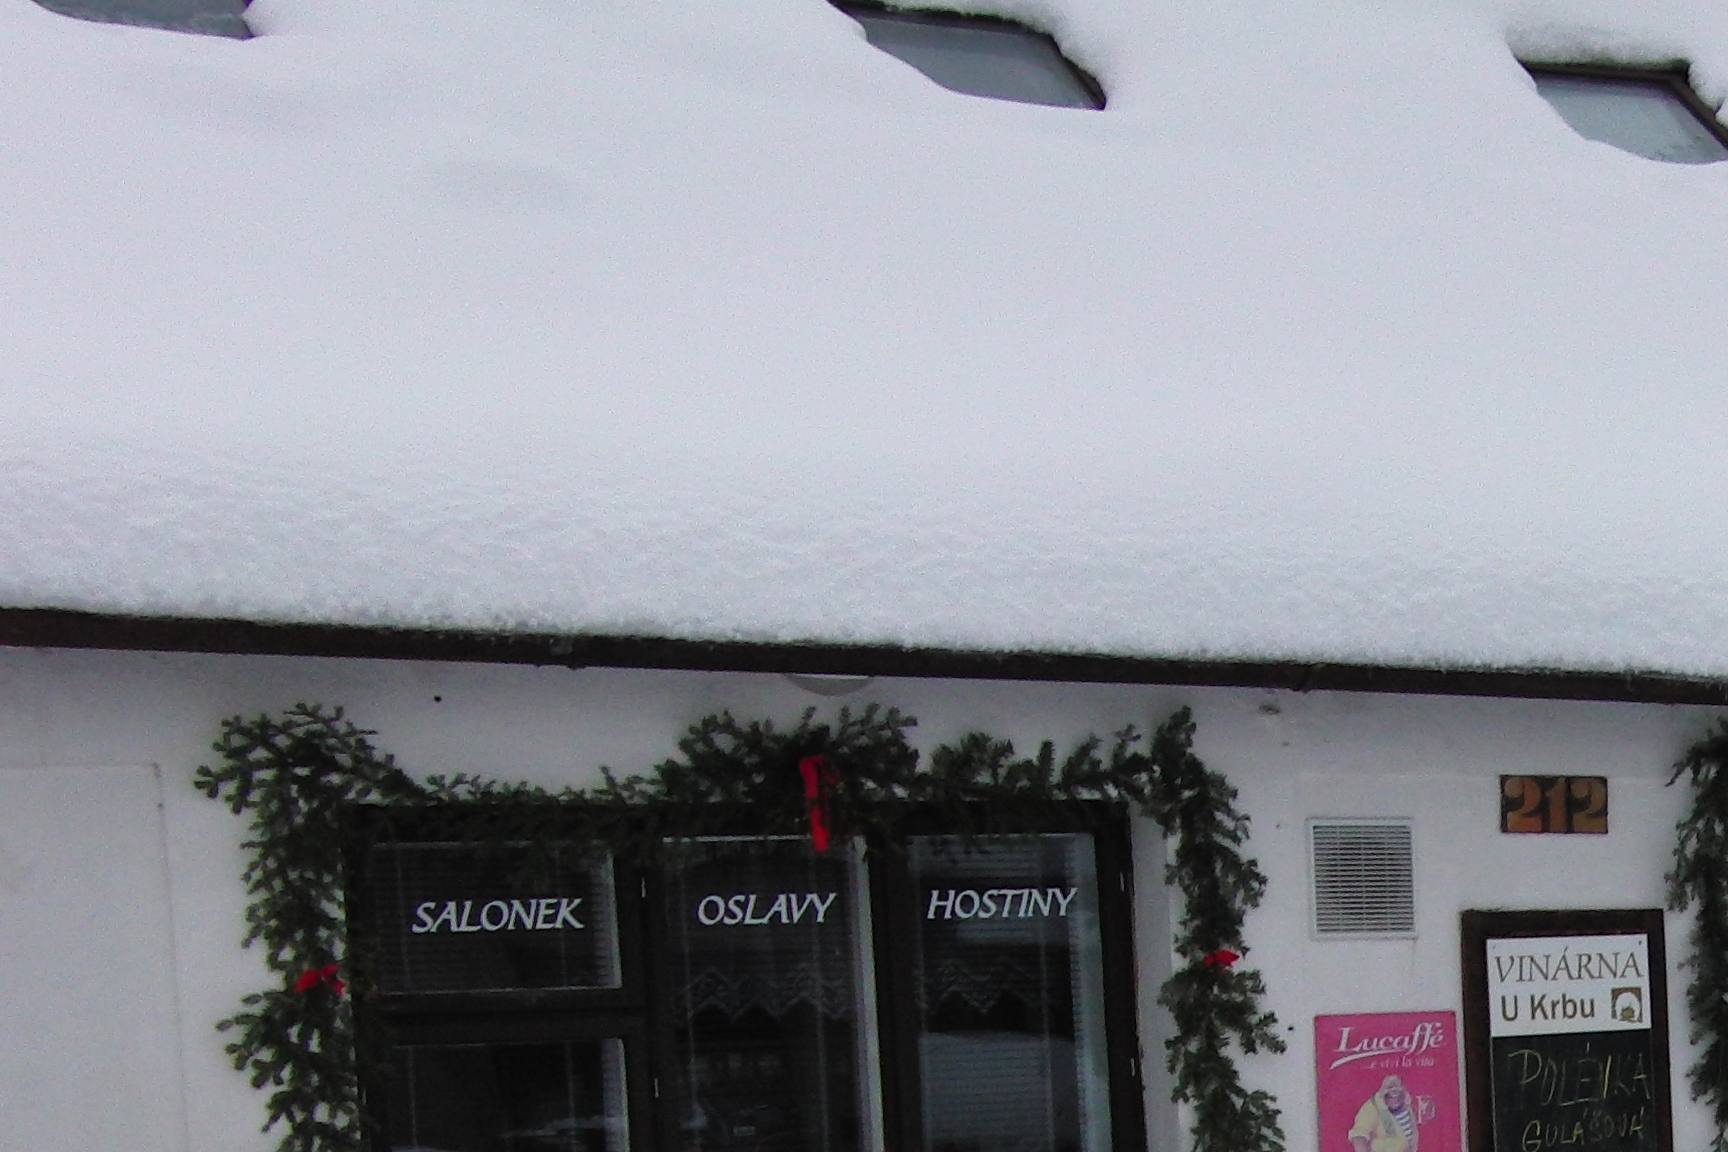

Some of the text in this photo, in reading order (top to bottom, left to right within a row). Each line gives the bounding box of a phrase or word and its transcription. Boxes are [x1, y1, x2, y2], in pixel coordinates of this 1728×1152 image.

[1503, 777, 1607, 832] 212
[411, 898, 585, 933] SALONEK
[698, 892, 836, 926] OSLAVY
[927, 887, 1078, 921] HOSTINY
[1494, 945, 1645, 983] VINÁRNA
[1501, 993, 1596, 1022] U Krbu
[1333, 1021, 1444, 1056] Lucaffé
